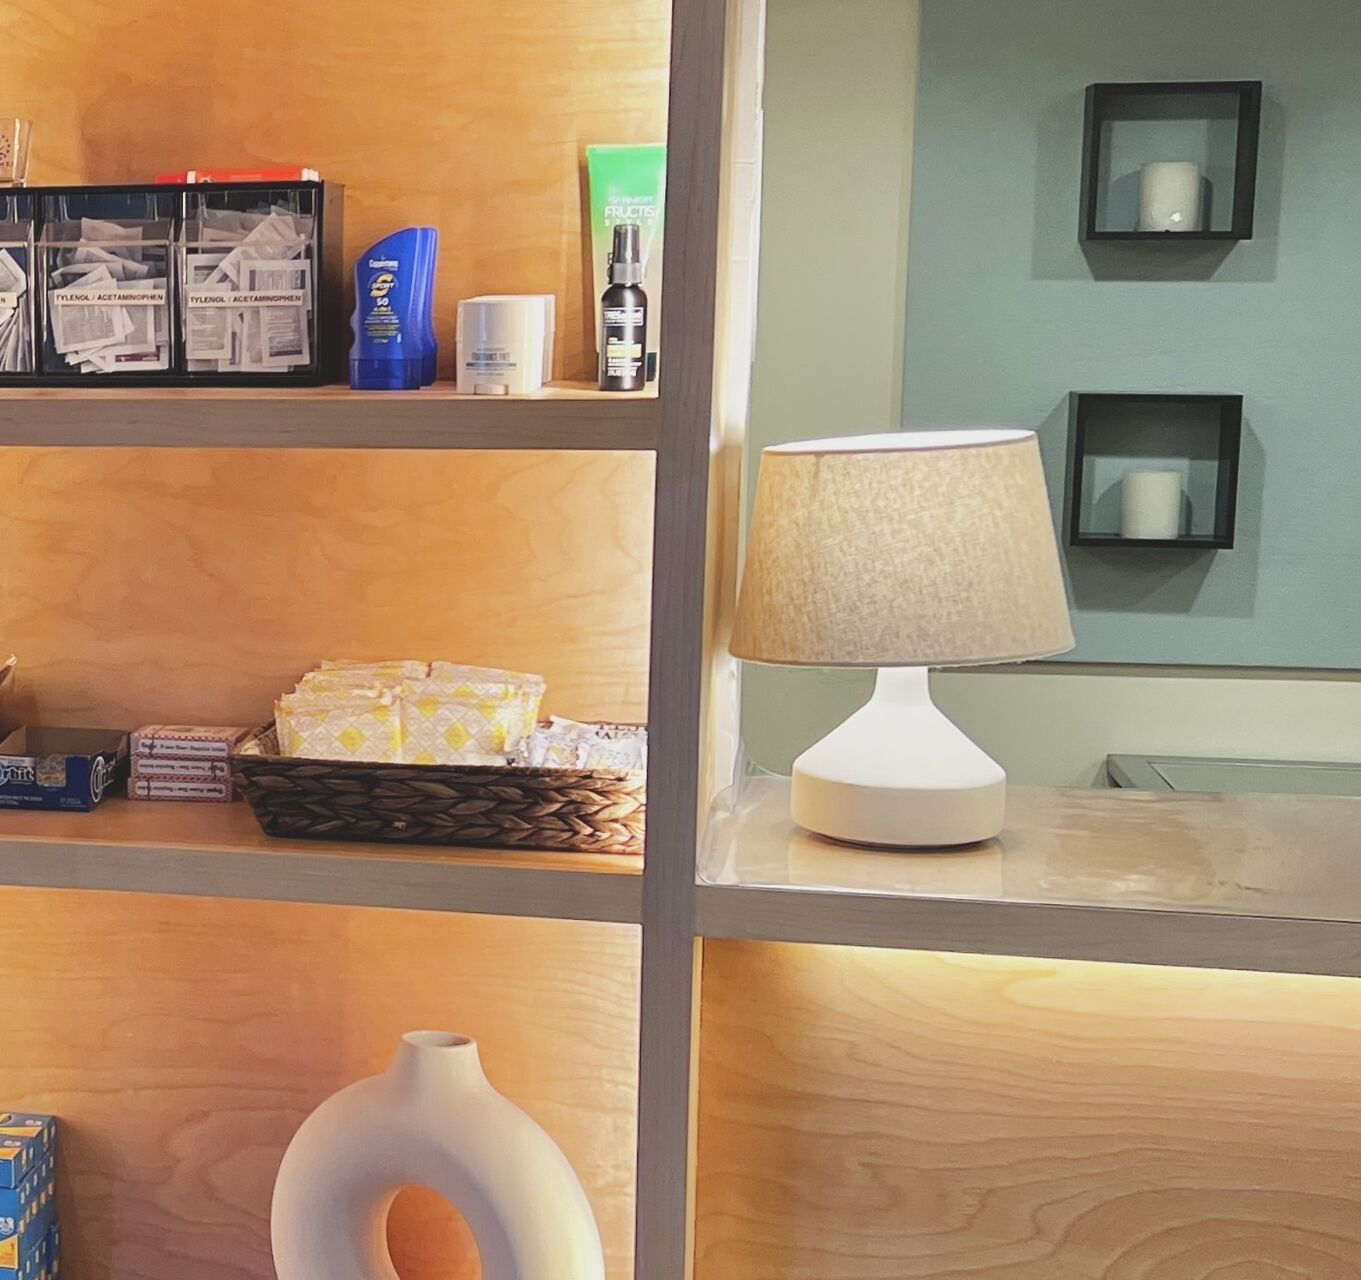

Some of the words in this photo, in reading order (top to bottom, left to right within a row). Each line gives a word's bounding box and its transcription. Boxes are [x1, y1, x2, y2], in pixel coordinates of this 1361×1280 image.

[604, 206, 655, 218] FRUCTIS
[56, 294, 91, 302] TYLENOL
[97, 293, 164, 302] ACETAMINOPHEN
[190, 296, 226, 304] TYLENOL
[232, 295, 302, 303] ACETAMINOPHEN
